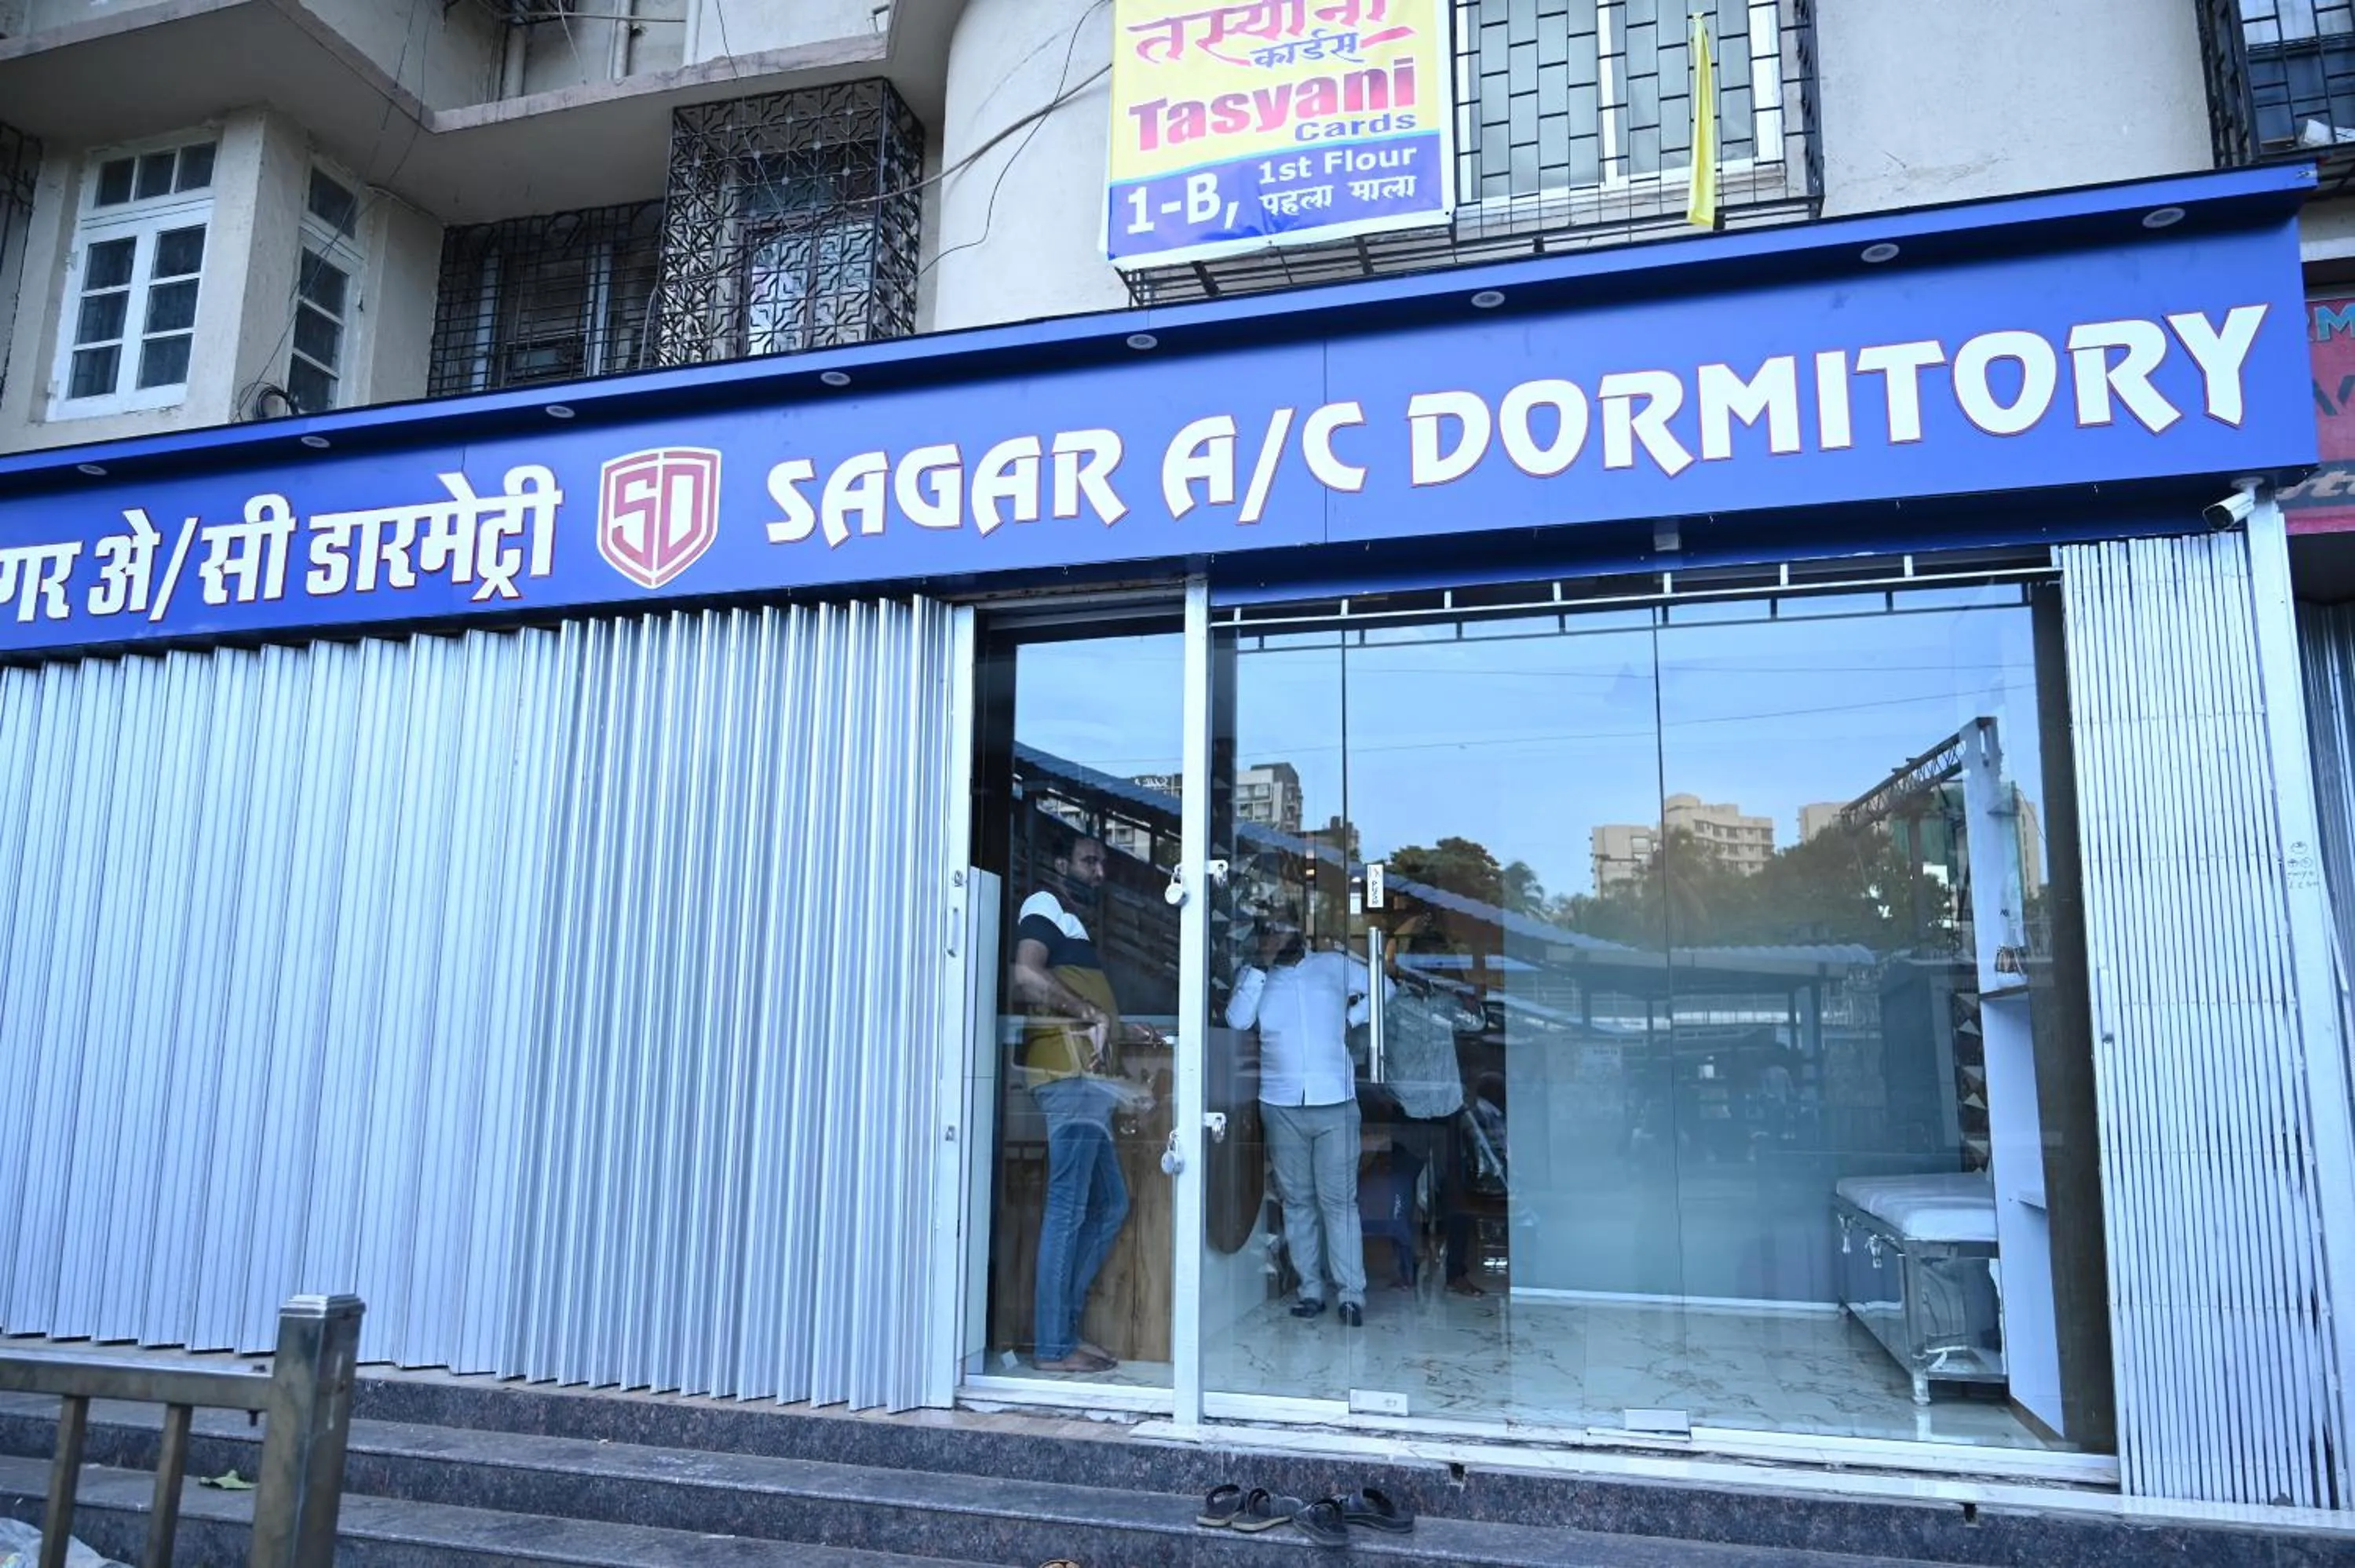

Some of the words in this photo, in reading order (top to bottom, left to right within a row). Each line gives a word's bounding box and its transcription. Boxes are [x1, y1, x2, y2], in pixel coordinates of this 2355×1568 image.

[1128, 57, 1415, 151] Tasyani
[1294, 113, 1416, 141] Cards
[1258, 156, 1313, 184] 1st
[1324, 147, 1417, 174] Flour
[1258, 184, 1334, 216] पहला
[1348, 175, 1417, 202] माला
[1127, 173, 1240, 234] 1-B,
[765, 428, 1130, 549] SAGAR
[1162, 400, 1369, 527] A/C
[1407, 302, 2271, 488] DORMITORY
[305, 464, 564, 602] डारमेट्री
